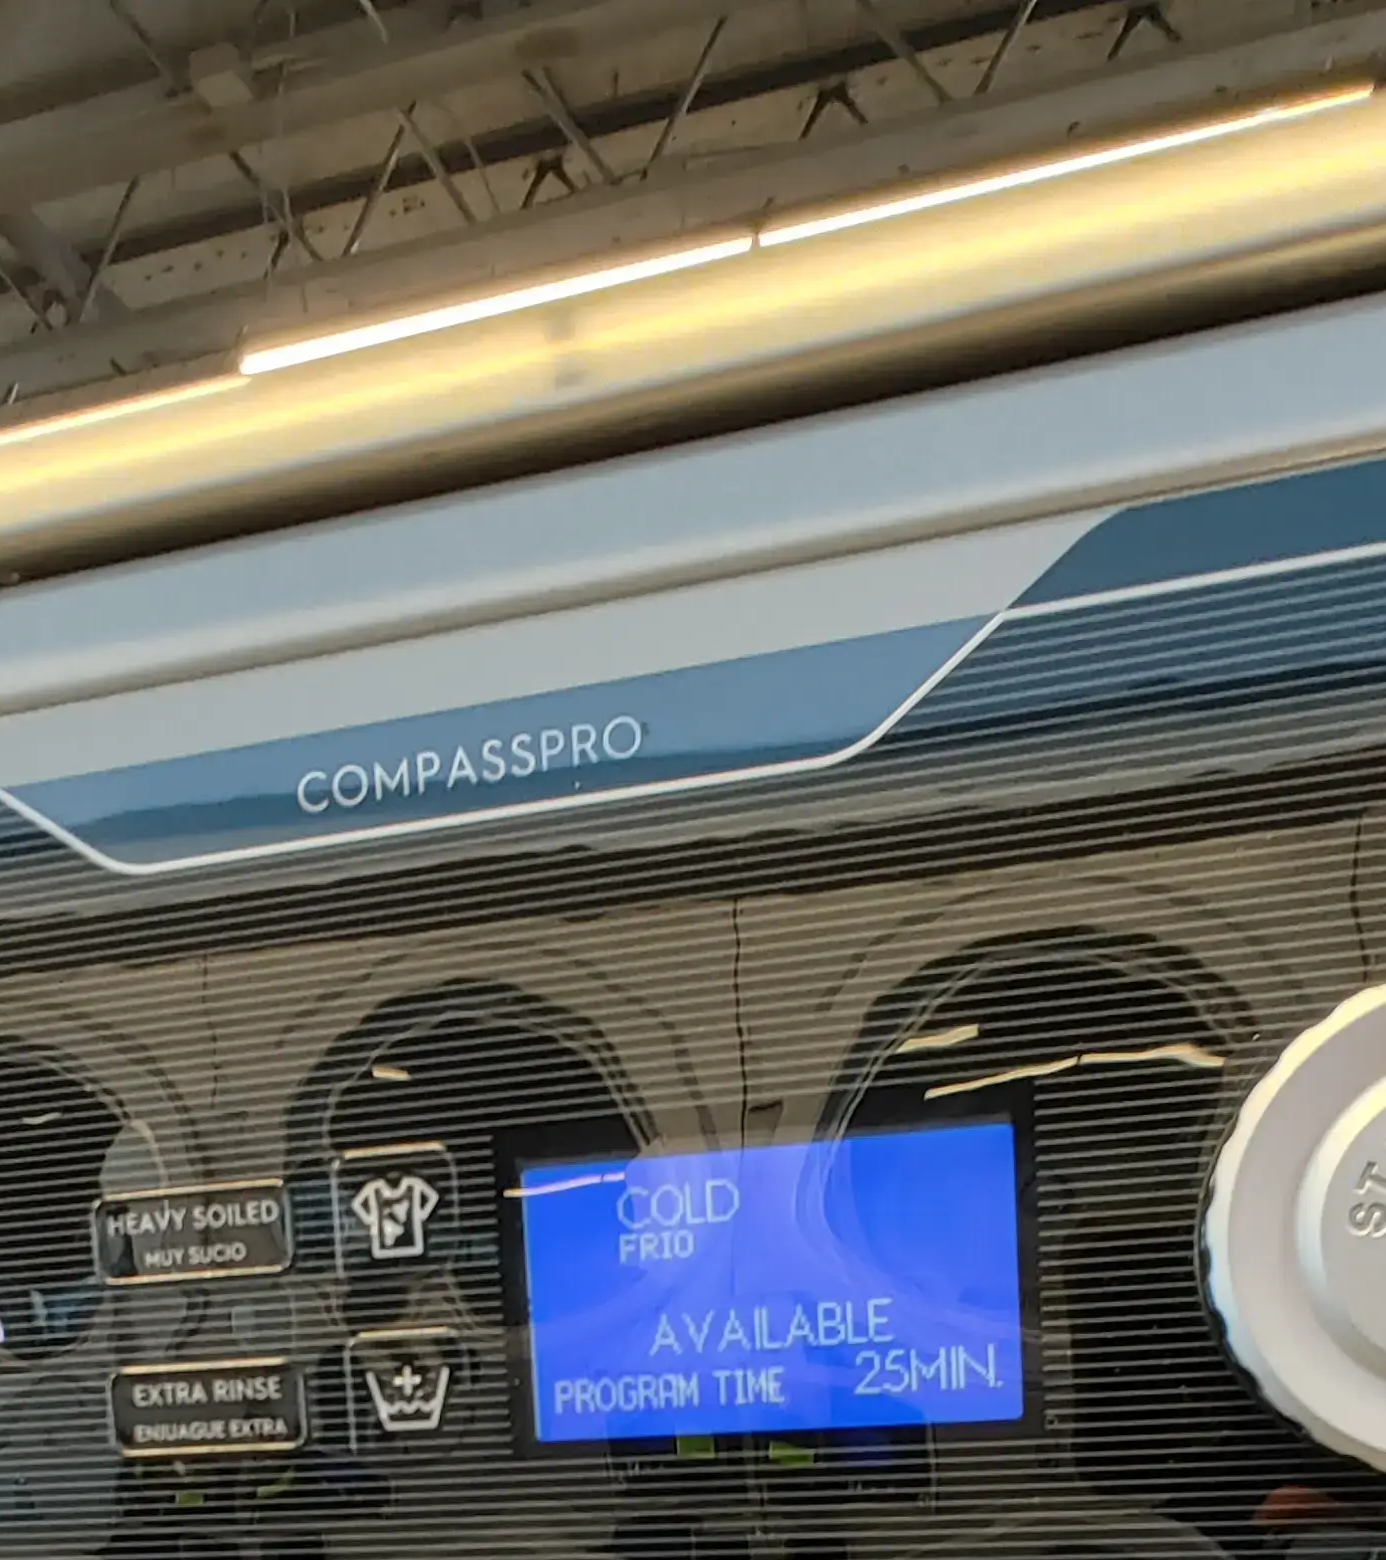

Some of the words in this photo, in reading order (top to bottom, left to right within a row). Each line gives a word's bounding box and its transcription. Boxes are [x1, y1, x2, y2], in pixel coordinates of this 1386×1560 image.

[297, 715, 642, 813] COMPASSPRO
[106, 1206, 187, 1237] HEAVY
[192, 1199, 280, 1232] SOILED
[616, 1178, 741, 1230] COLD
[144, 1247, 185, 1269] MUY
[188, 1241, 248, 1265] SUCIO
[618, 1229, 696, 1265] FRIO
[649, 1297, 894, 1357] AVAILABLE
[132, 1380, 209, 1408] EXTRA
[213, 1375, 283, 1403] RINSE
[554, 1371, 700, 1415] PROGRAM
[716, 1366, 786, 1407] TIME
[133, 1419, 227, 1444] ENJUAGUE
[228, 1416, 289, 1439] EXTRA
